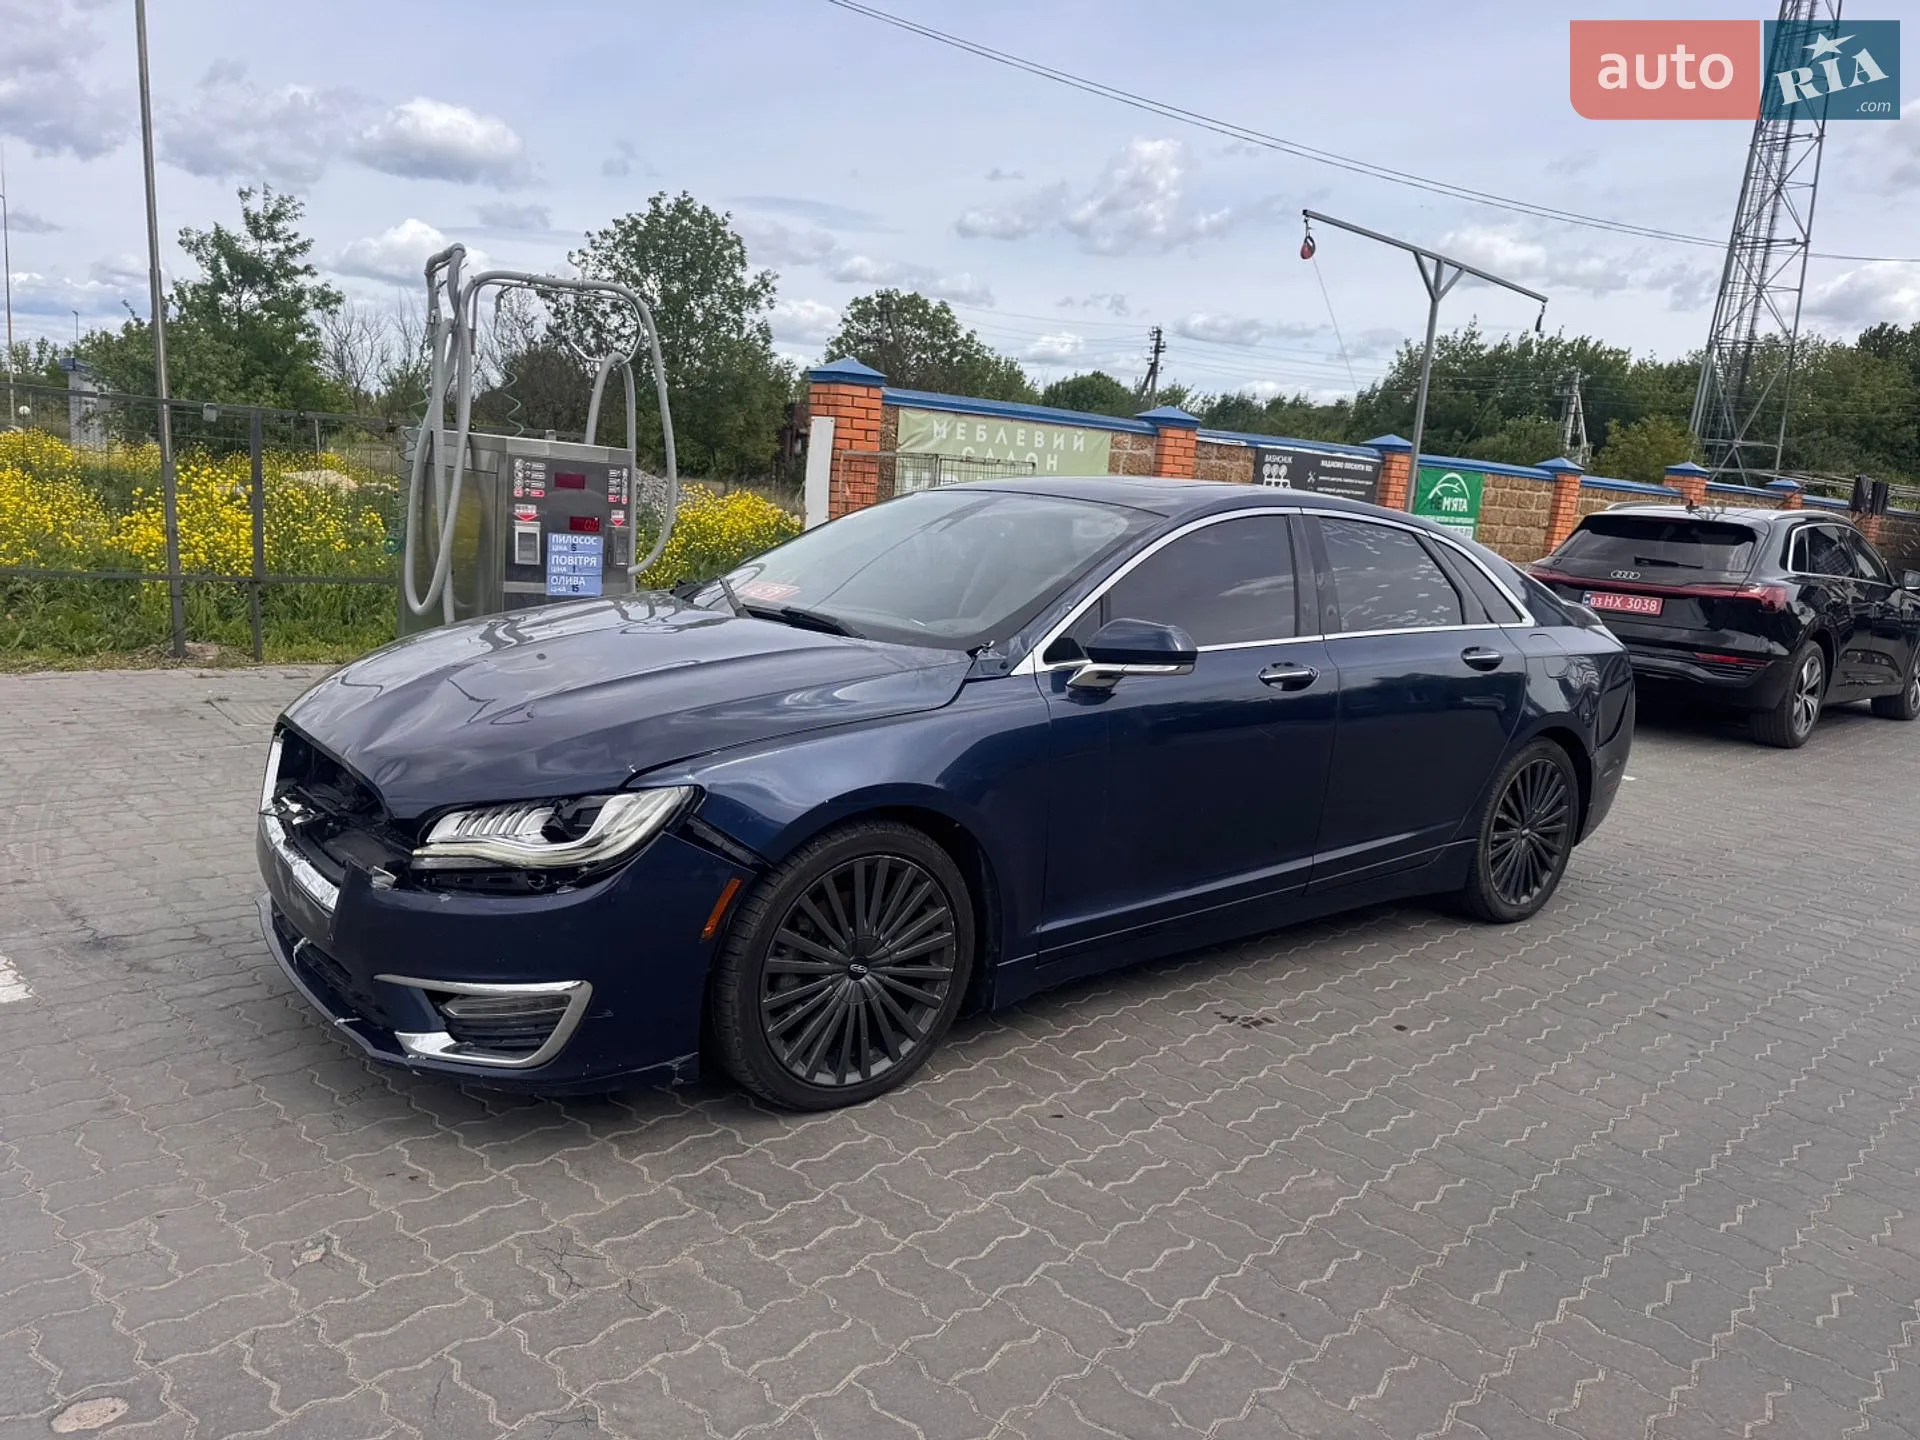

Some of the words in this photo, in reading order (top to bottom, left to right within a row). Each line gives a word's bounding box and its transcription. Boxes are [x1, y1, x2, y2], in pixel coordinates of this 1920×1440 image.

[933, 419, 1085, 452] МЕБЛЕВИЙ
[552, 534, 598, 545] ПИЛОСОС
[551, 555, 597, 566] ПОВІТРЯ
[550, 575, 586, 586] ОЛИВА
[1590, 597, 1603, 605] 03
[1604, 595, 1623, 608] HX
[1627, 597, 1657, 611] 3038
